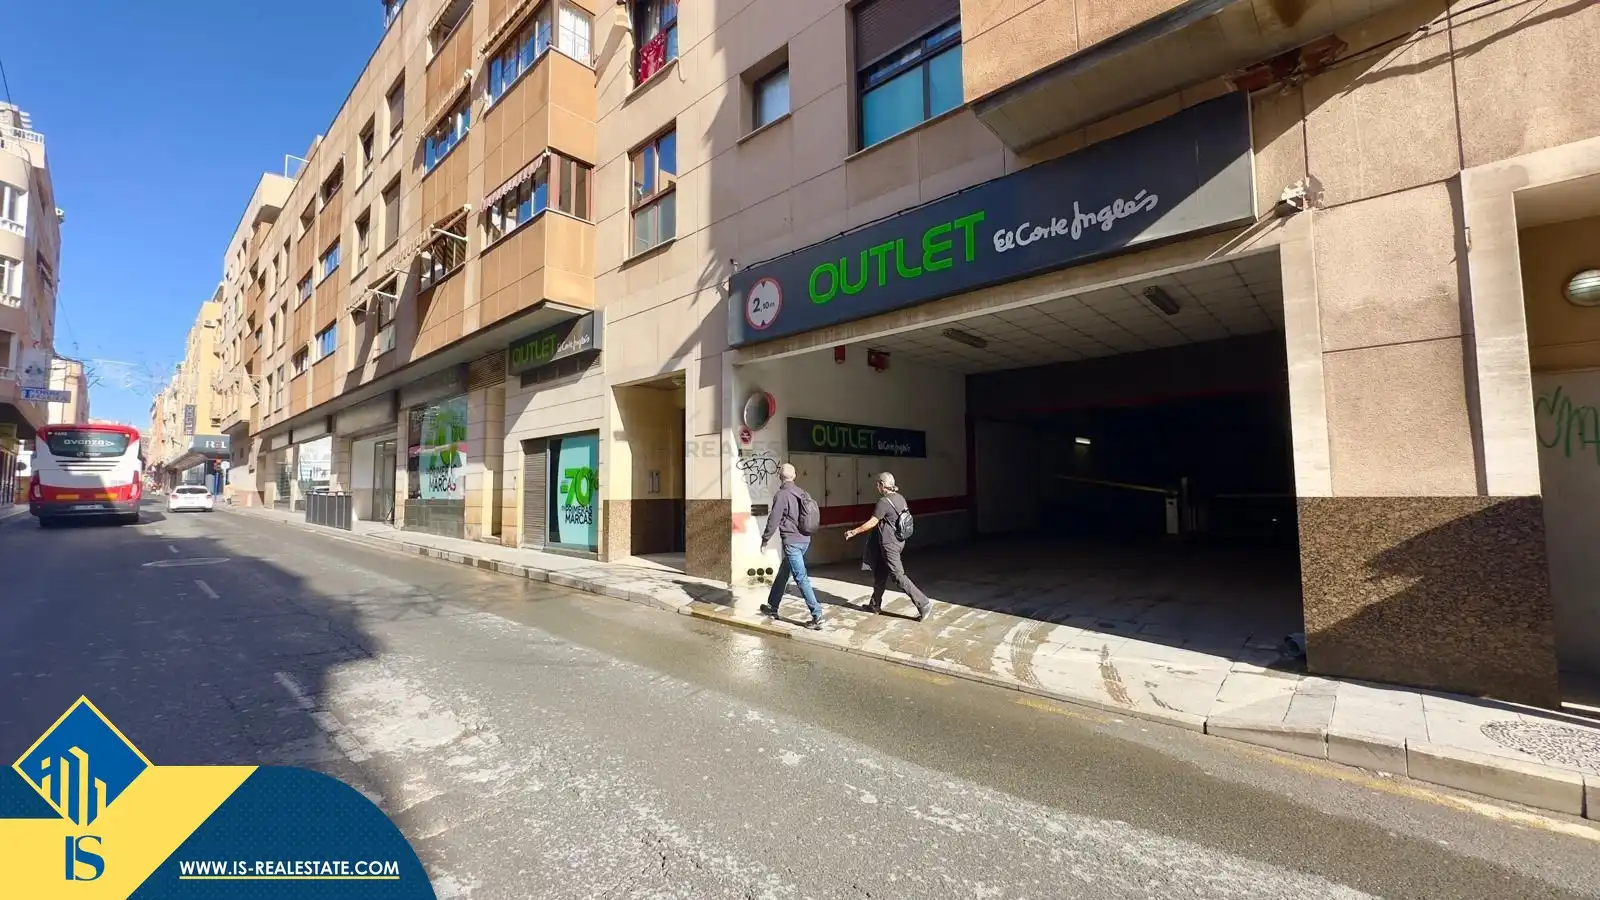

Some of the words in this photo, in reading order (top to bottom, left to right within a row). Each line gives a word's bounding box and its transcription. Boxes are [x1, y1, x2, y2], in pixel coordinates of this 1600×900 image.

[808, 211, 985, 304] OUTLET
[993, 228, 1015, 253] El
[1015, 217, 1068, 246] Corte
[1071, 189, 1159, 240] Inglés
[512, 333, 557, 368] OUTLET
[812, 424, 877, 450] OUTLET
[565, 512, 592, 525] MARCAS
